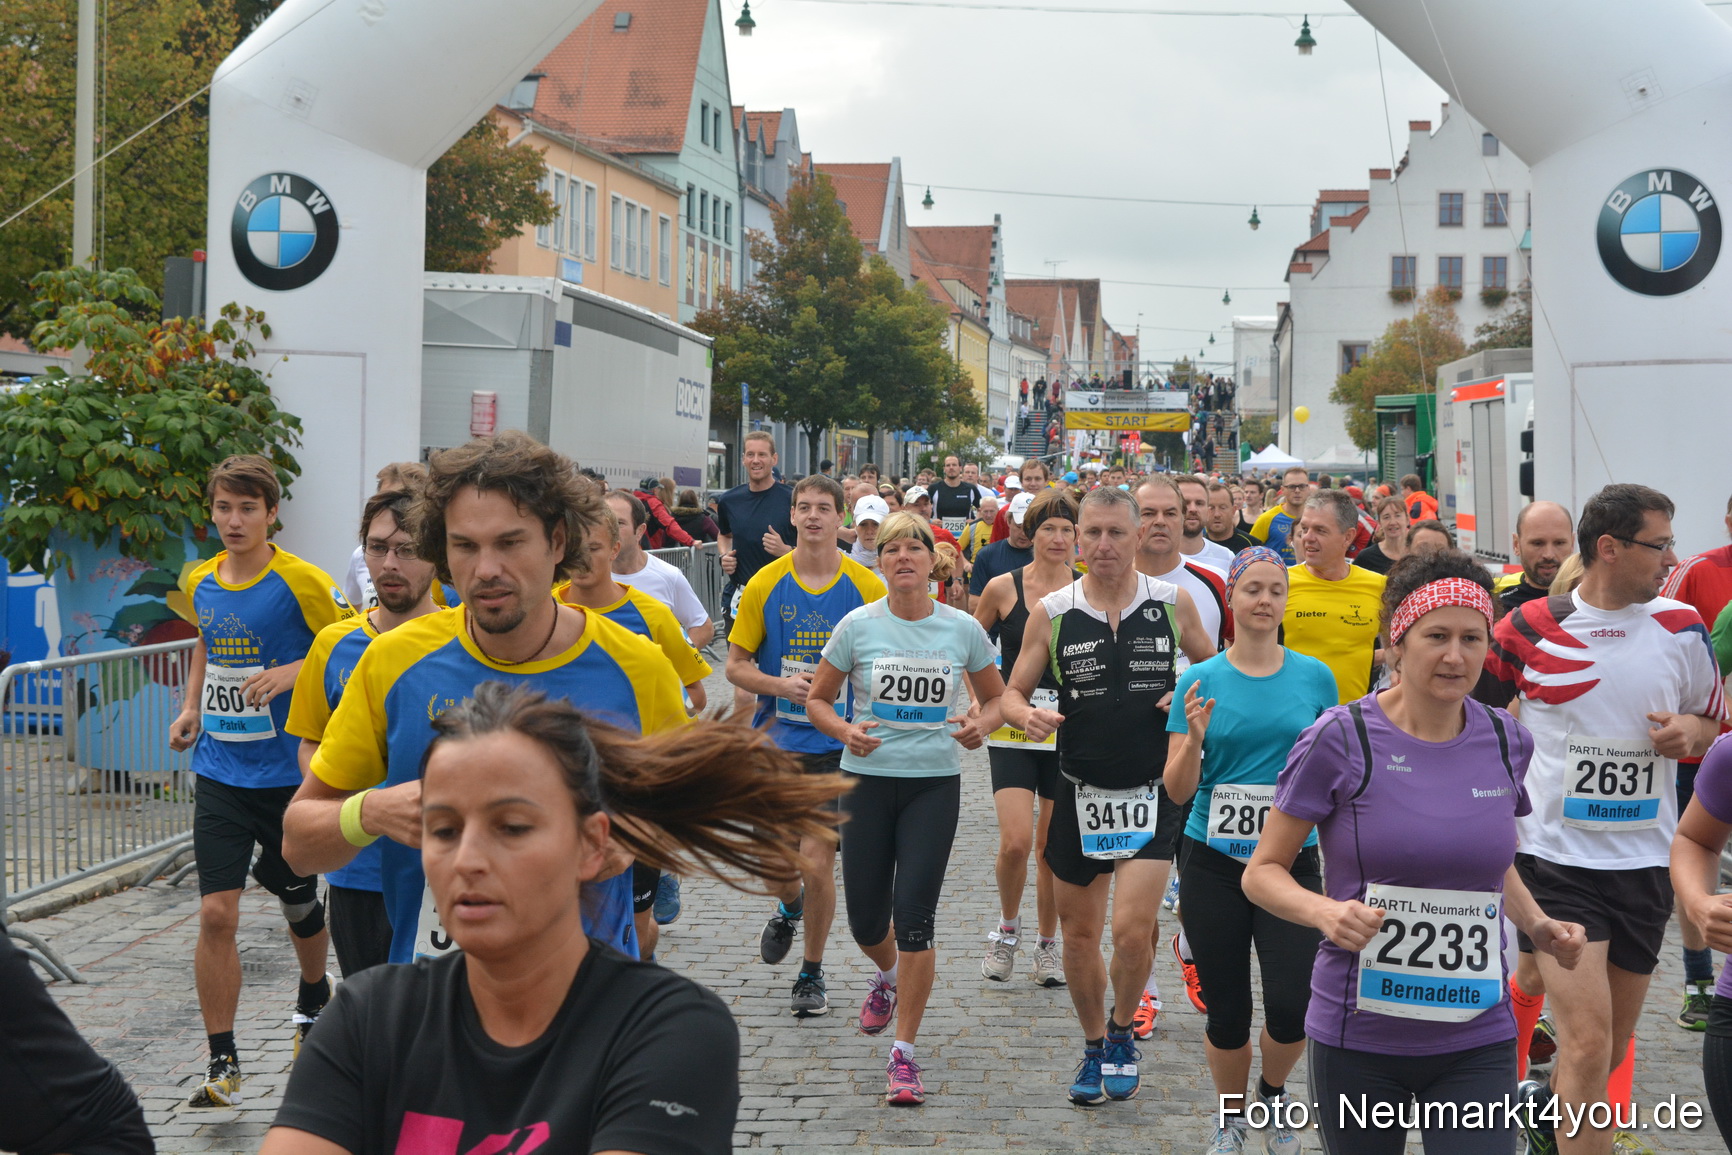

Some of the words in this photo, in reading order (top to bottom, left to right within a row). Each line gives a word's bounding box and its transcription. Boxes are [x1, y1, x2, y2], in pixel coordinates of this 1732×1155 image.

[239, 175, 331, 215] BMW
[1606, 171, 1714, 214] BMW
[676, 377, 705, 421] BOCK
[1105, 416, 1148, 426] START
[945, 522, 964, 531] 2256
[1590, 628, 1626, 638] adidas
[874, 664, 901, 672] PARTL
[902, 665, 940, 674] Neumarkt
[879, 674, 946, 704] 2909
[896, 708, 923, 720] Karin
[220, 719, 247, 732] Patrik
[1569, 745, 1604, 756] PARTL
[1606, 748, 1652, 758] Neumarkt
[1386, 764, 1412, 773] erima
[1575, 760, 1654, 796] 2631
[1213, 791, 1242, 801] PARTL
[1086, 802, 1149, 830] 3410
[1587, 803, 1641, 818] Manfred
[1096, 835, 1132, 851] KURT
[1368, 897, 1417, 913] PARTL
[1420, 901, 1481, 917] Neumarkt
[1376, 918, 1489, 972] 2233
[1381, 977, 1481, 1004] Bernadette
